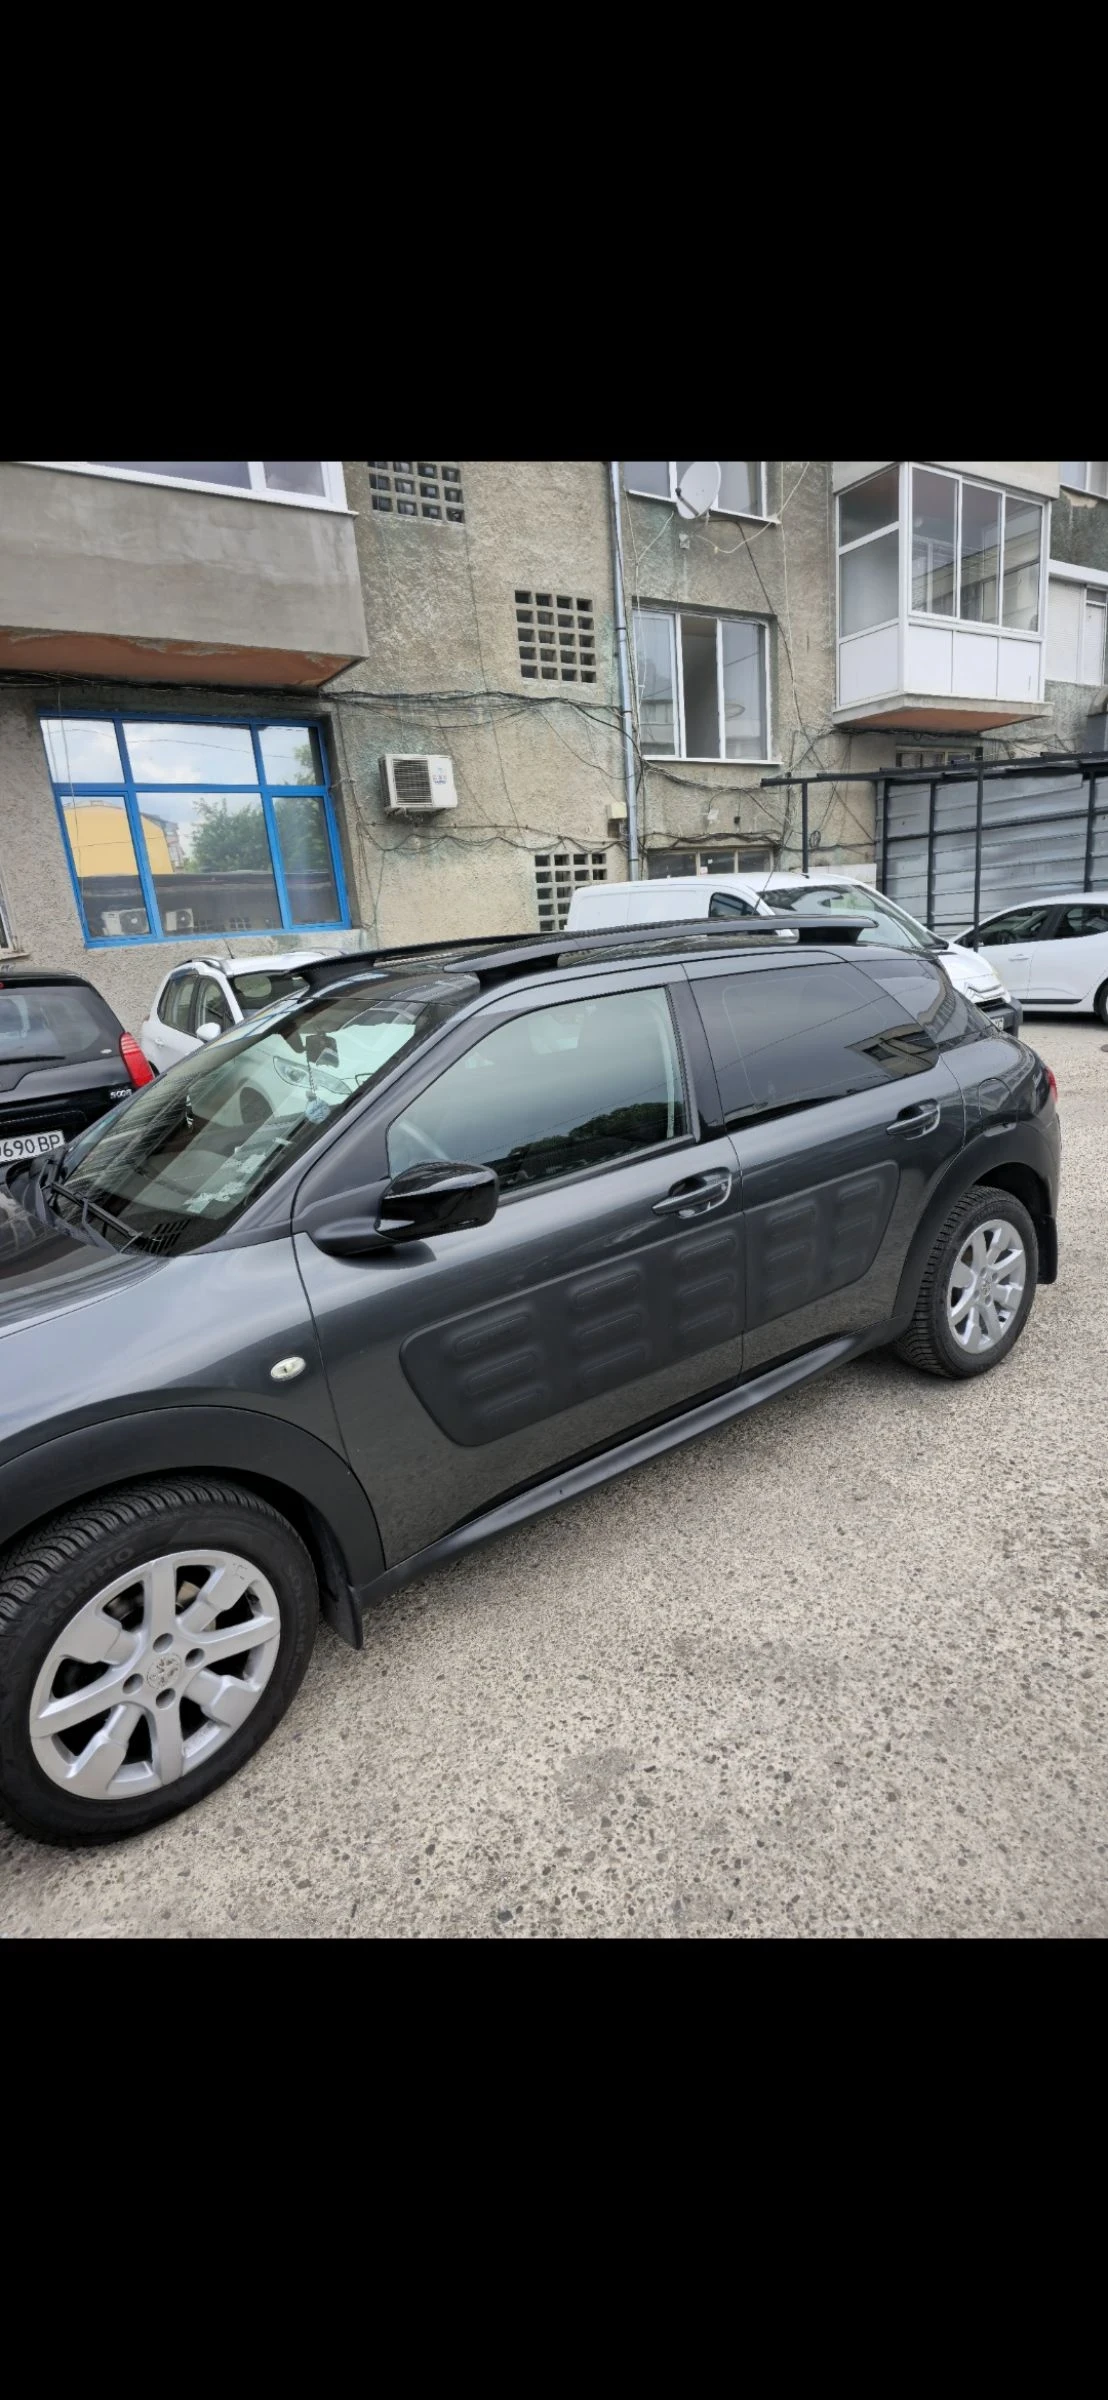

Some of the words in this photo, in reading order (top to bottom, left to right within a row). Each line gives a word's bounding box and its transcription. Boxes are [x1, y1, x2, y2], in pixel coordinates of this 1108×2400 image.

[0, 1139, 35, 1158] 690
[38, 1134, 61, 1152] BP
[41, 1547, 134, 1625] KUMHO
